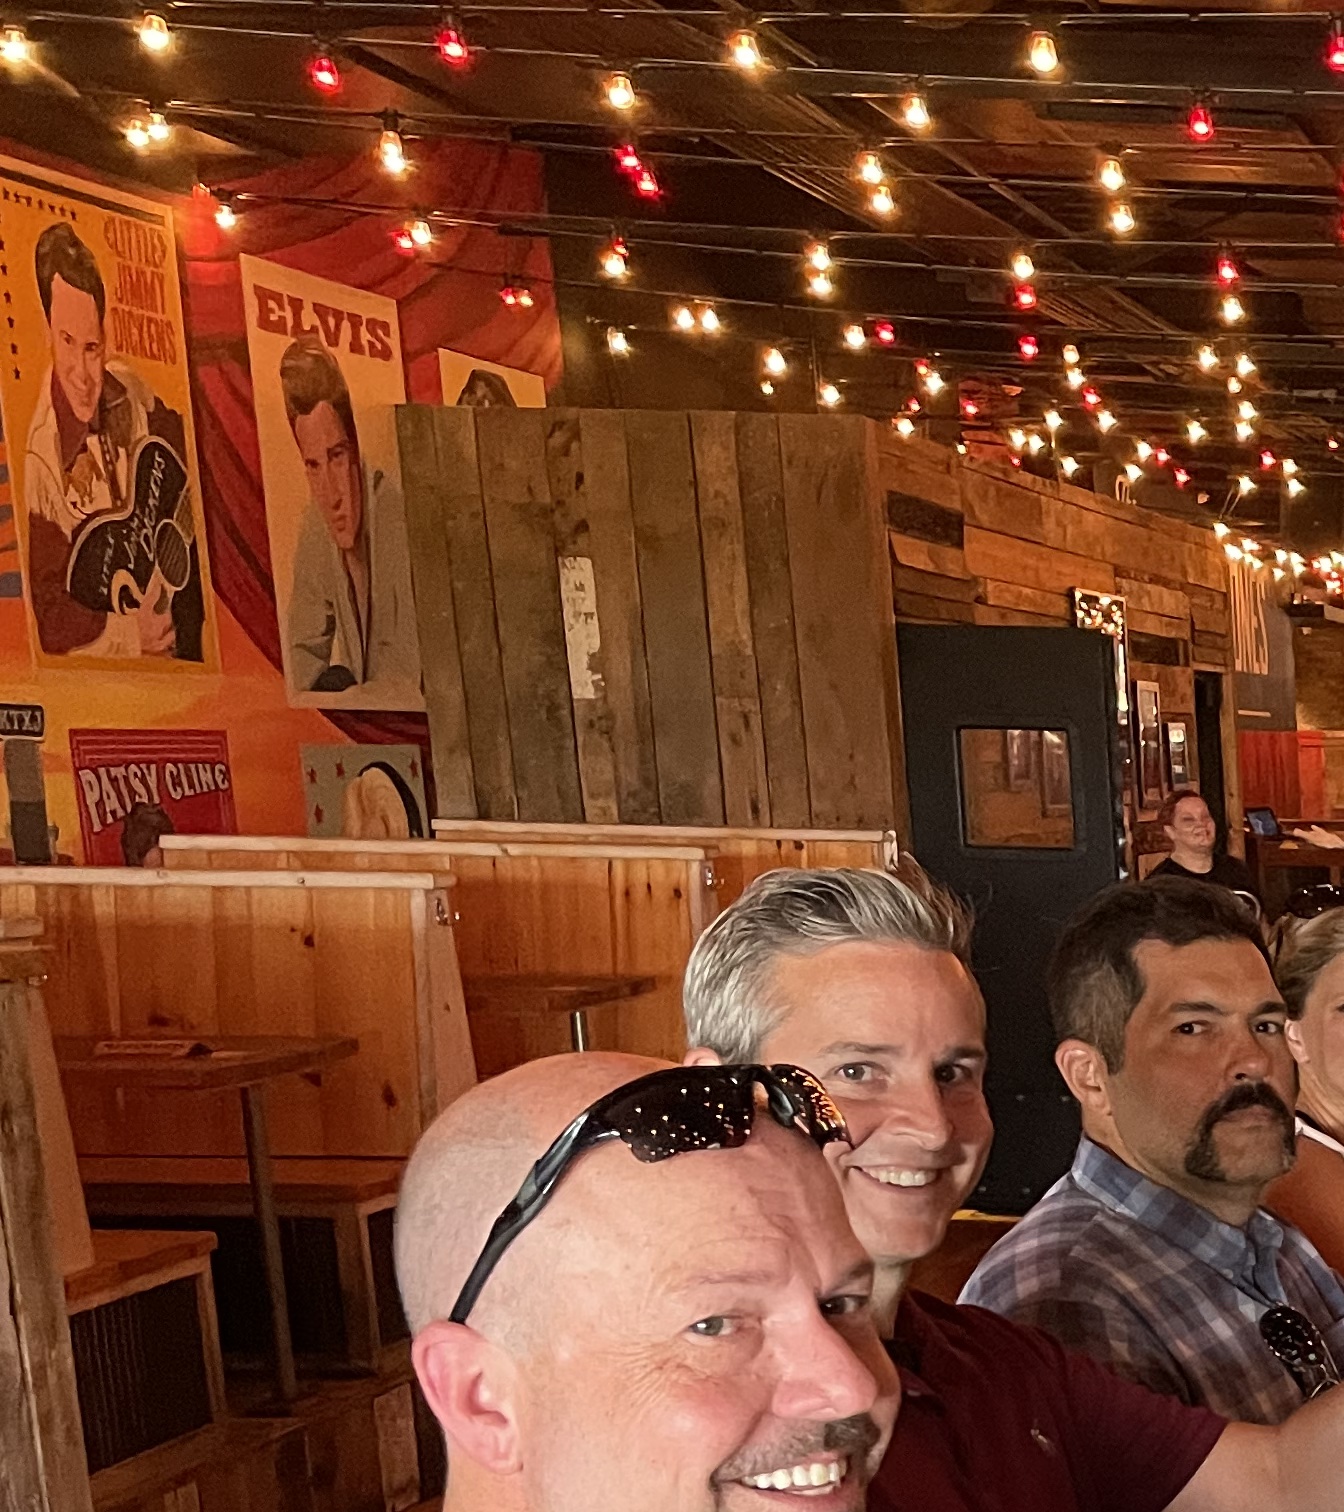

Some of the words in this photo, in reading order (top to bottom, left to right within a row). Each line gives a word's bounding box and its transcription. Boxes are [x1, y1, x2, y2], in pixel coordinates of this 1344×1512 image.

[111, 307, 177, 365] DICKENS
[253, 283, 393, 362] ELVIS
[79, 763, 160, 832] PATSY
[165, 763, 230, 801] CLINE
